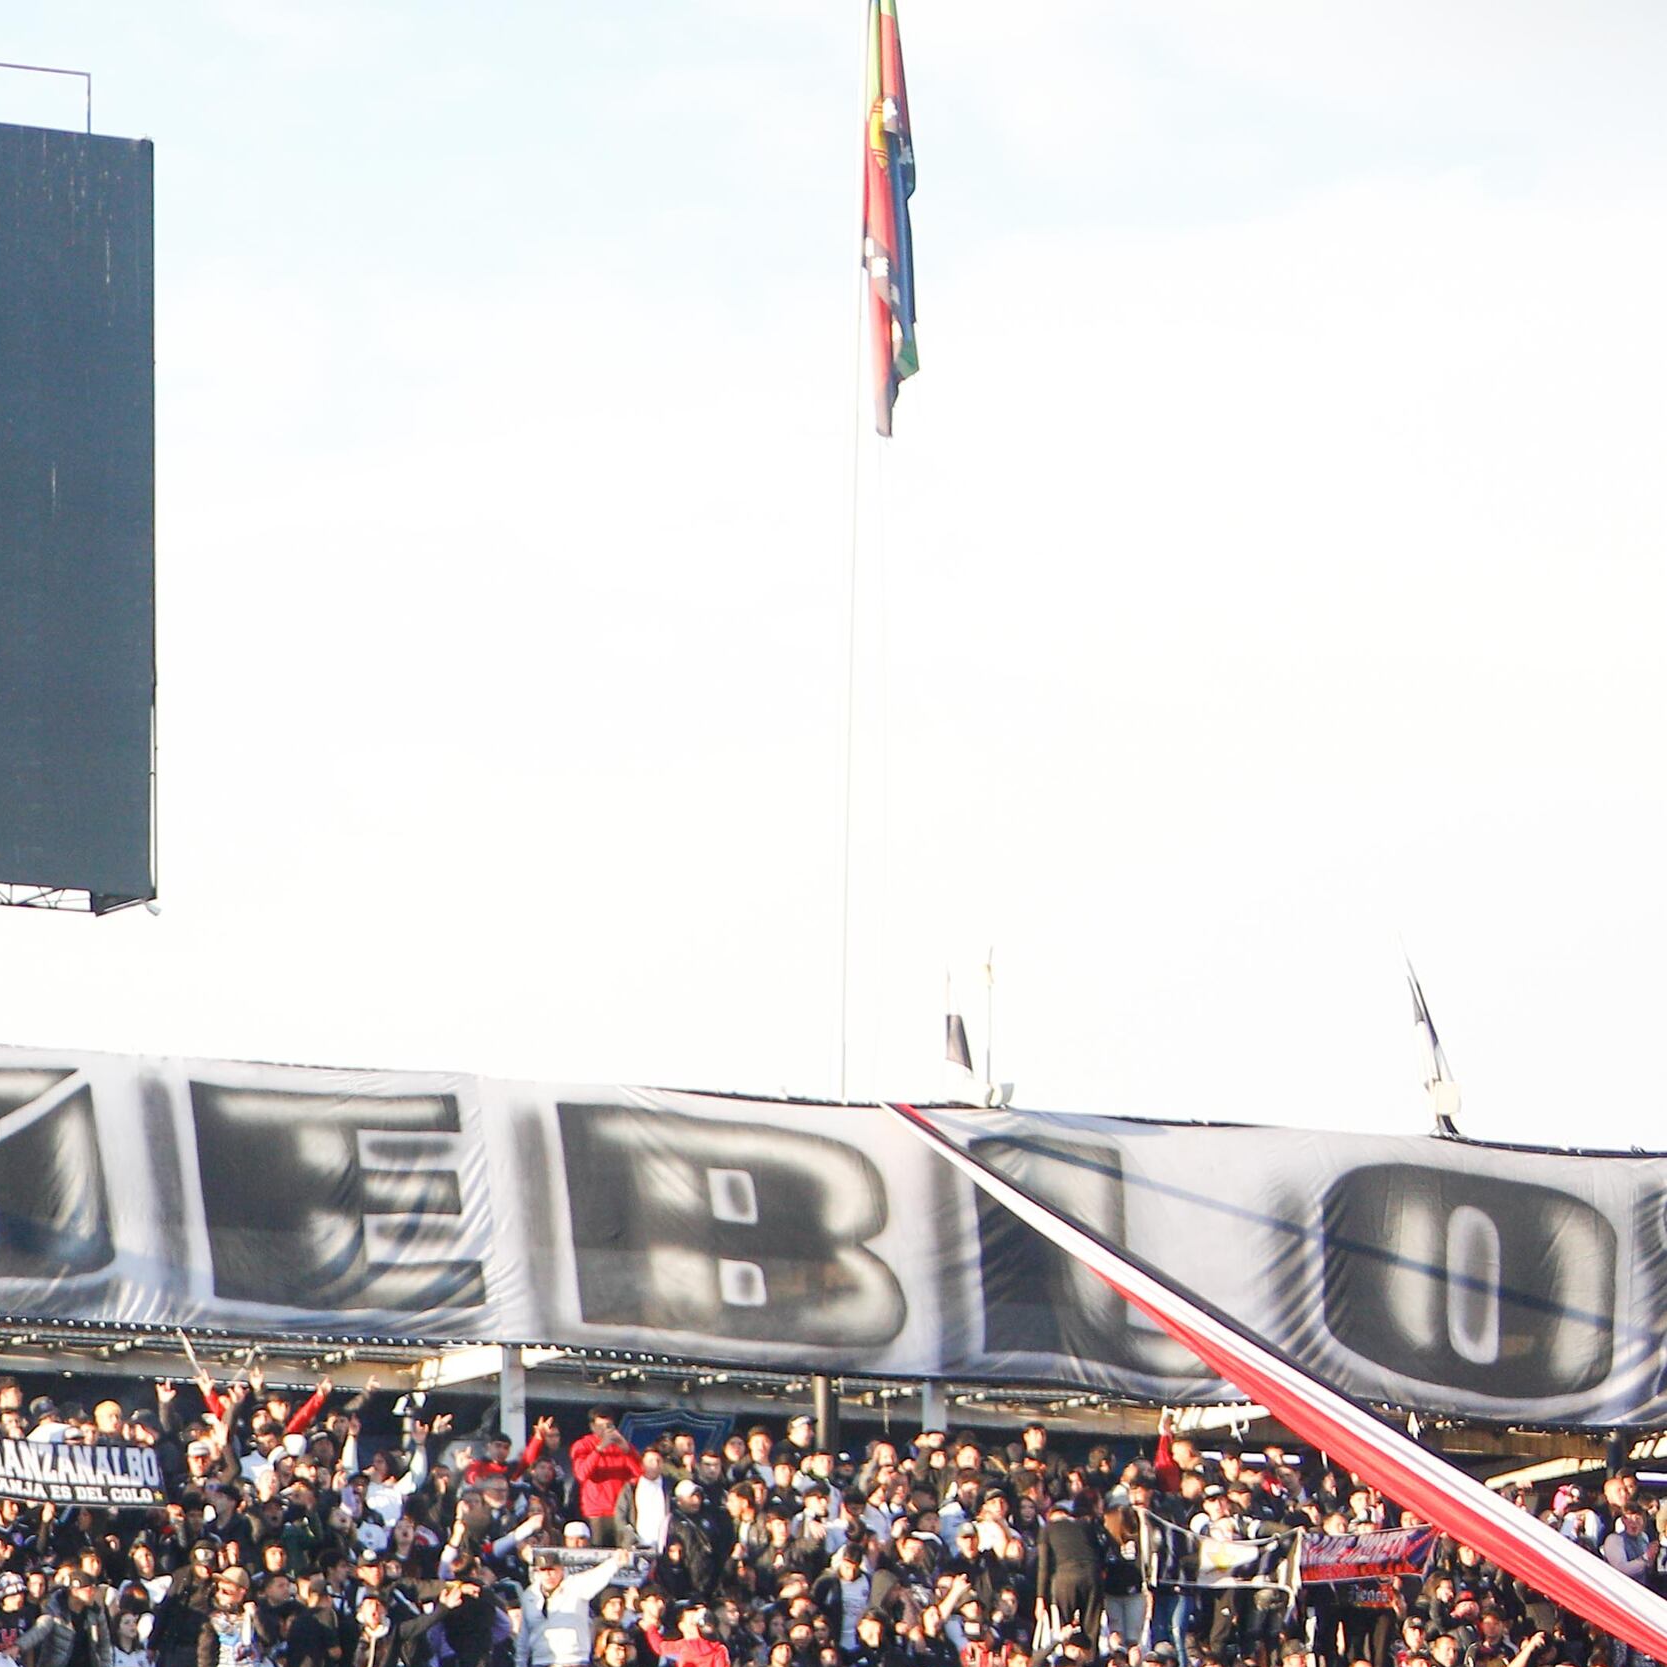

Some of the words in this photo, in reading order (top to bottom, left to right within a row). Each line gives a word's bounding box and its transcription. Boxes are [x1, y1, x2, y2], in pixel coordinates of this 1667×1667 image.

[49, 1483, 72, 1500] ES
[76, 1484, 109, 1503] DEL
[110, 1487, 154, 1504] COLO
